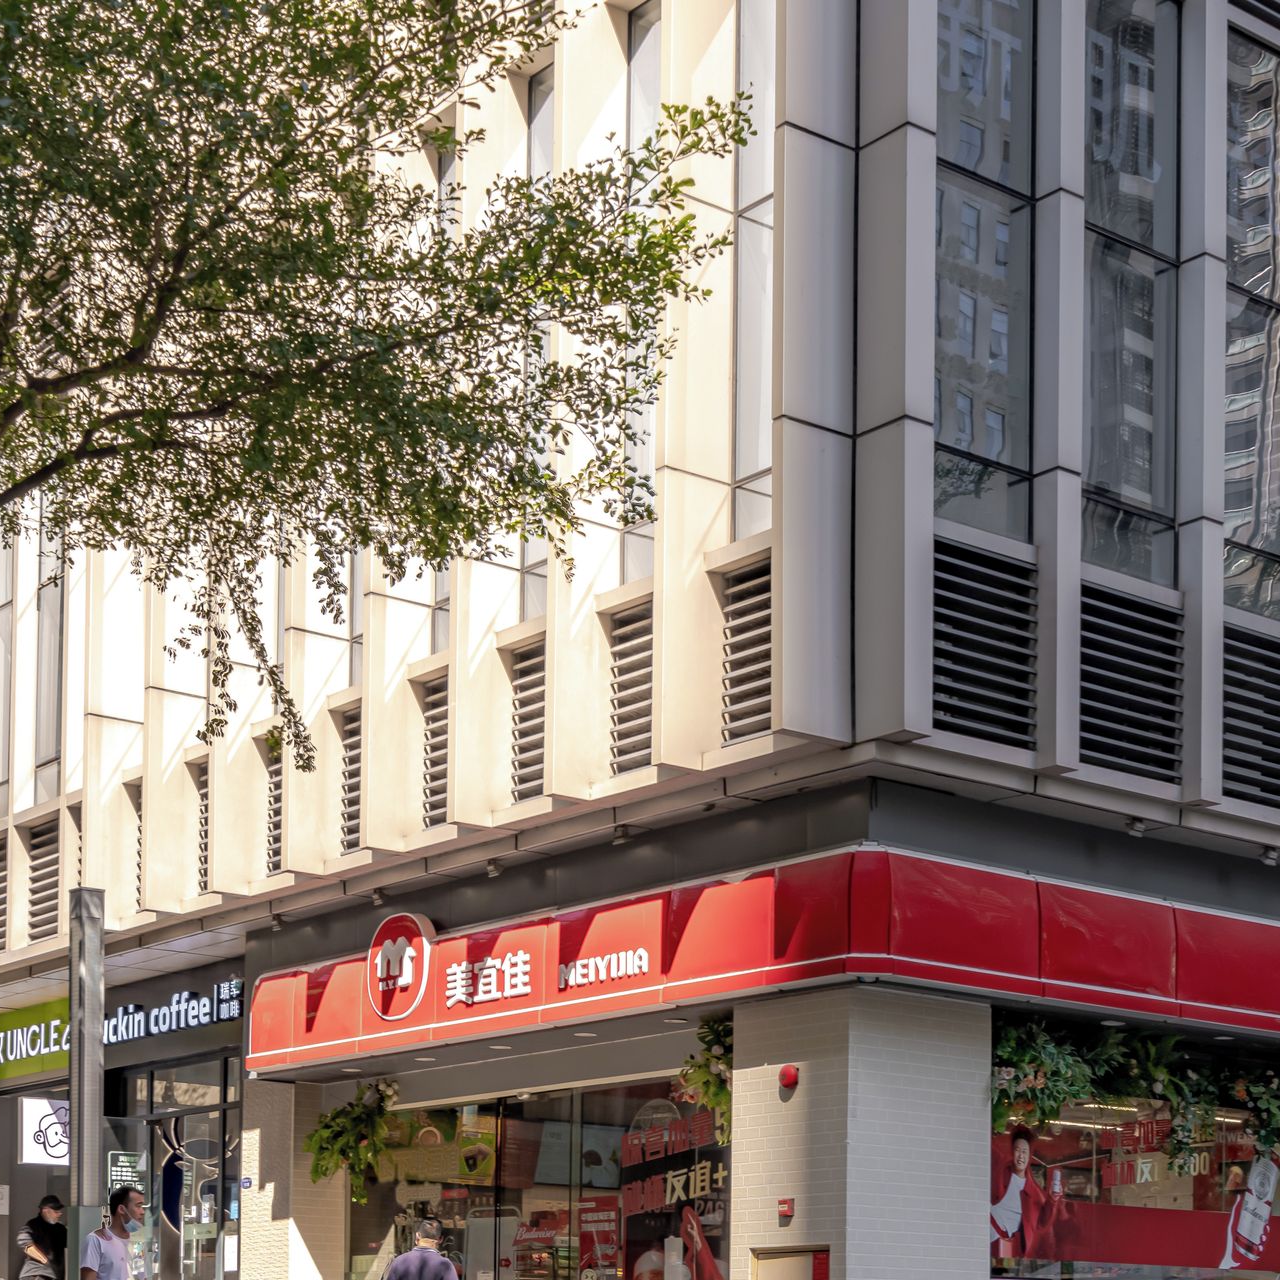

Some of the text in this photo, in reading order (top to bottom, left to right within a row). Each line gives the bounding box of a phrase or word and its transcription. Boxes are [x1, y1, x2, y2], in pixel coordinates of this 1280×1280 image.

[445, 949, 532, 1008] 美宜佳
[558, 947, 649, 990] MEIYIJIA
[149, 991, 211, 1034] coffee
[6, 1019, 61, 1061] UNCLE
